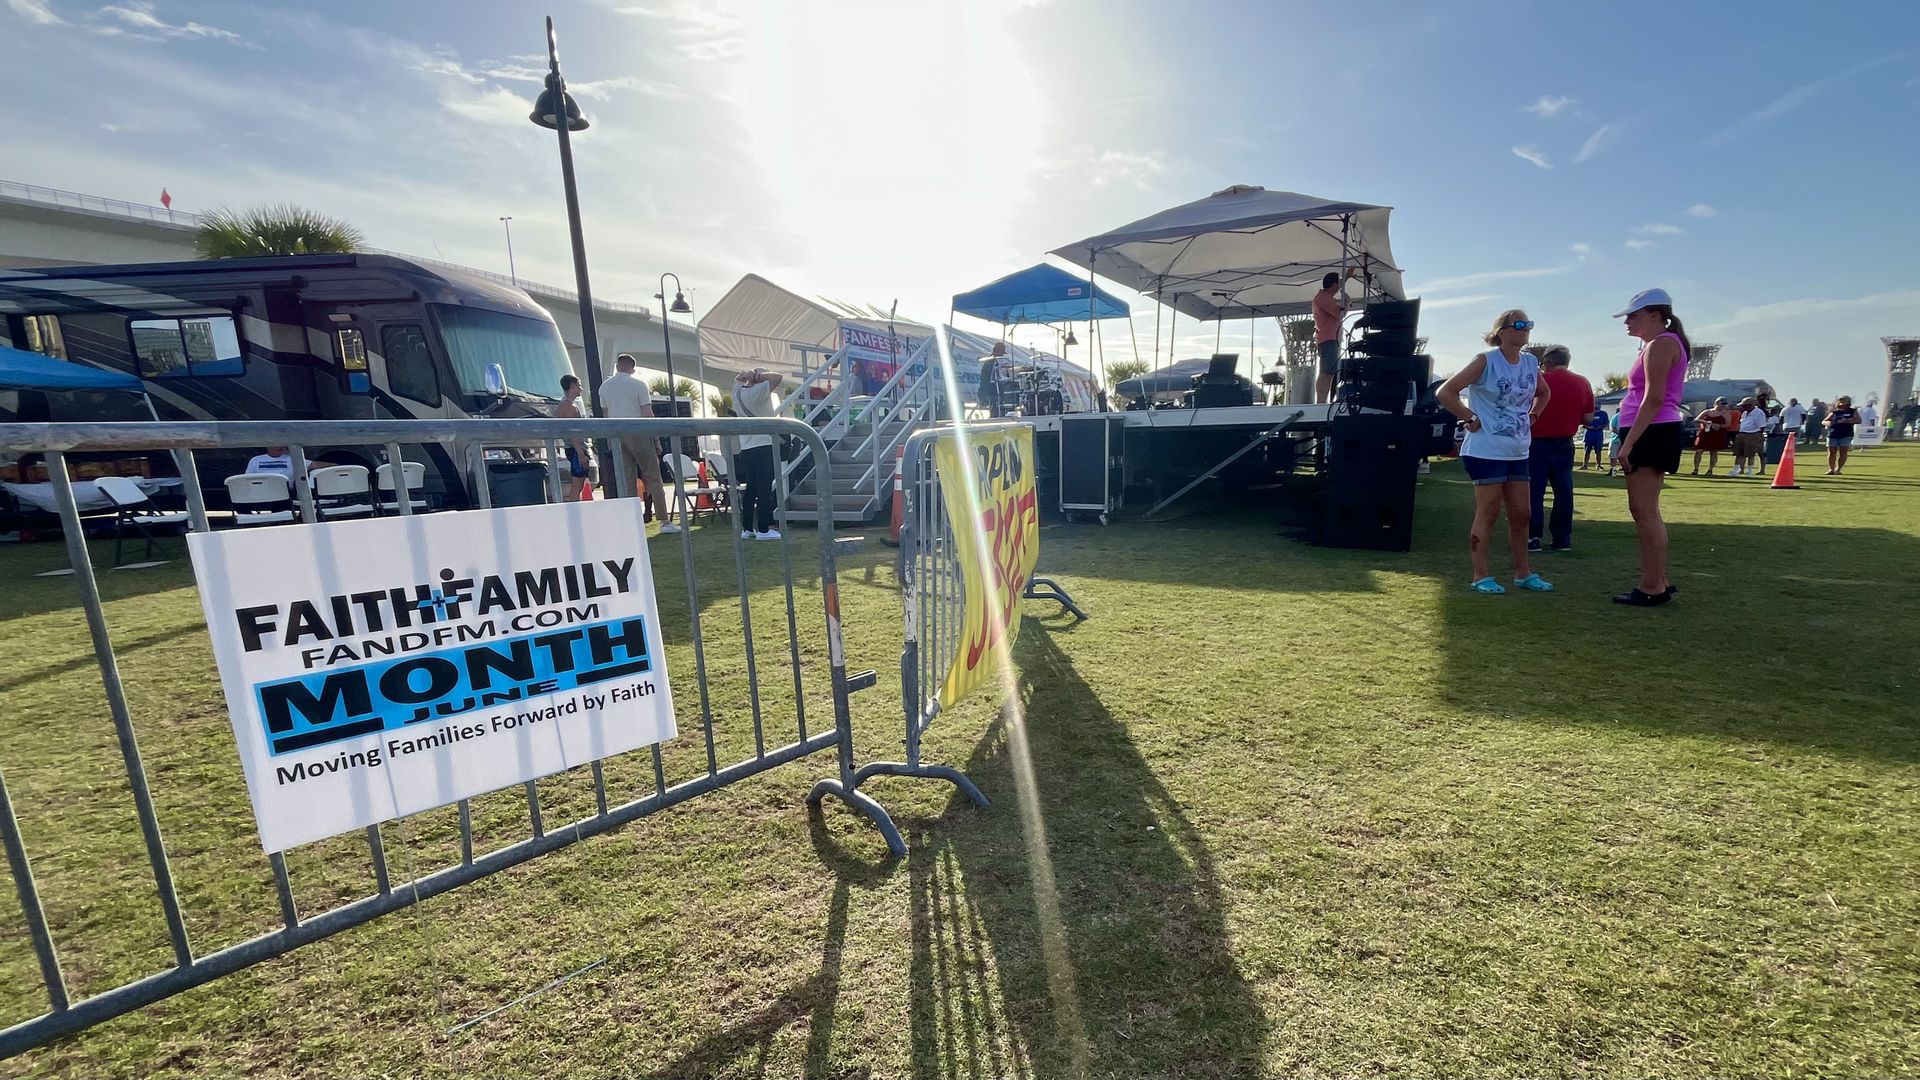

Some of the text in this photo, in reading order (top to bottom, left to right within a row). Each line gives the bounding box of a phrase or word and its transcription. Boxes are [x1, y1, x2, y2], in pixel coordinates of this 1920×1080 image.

[260, 619, 647, 733] MONTH
[302, 603, 599, 669] FANDFM.COM
[276, 680, 656, 785] Moving Families Forward by Faith
[404, 679, 560, 724] JUNE
